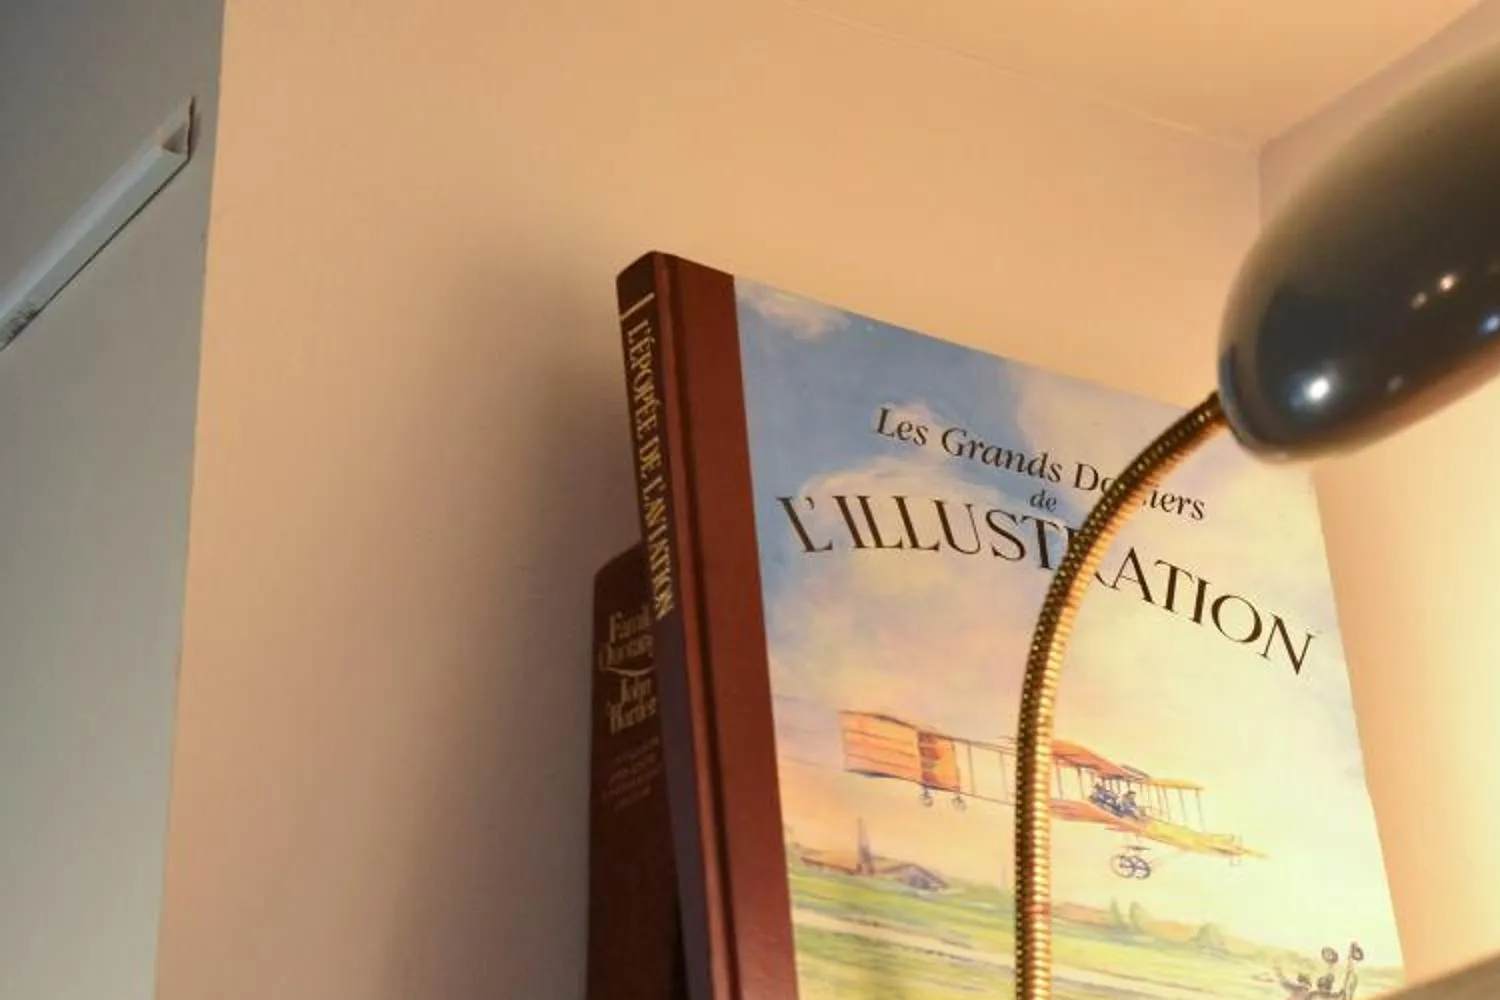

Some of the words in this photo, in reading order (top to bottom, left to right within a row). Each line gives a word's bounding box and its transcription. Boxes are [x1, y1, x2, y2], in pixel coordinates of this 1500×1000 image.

[638, 435, 663, 480] DE
[875, 407, 929, 447] Les
[941, 426, 1063, 484] Grands
[1072, 461, 1206, 521] Doiers
[1029, 488, 1057, 512] de
